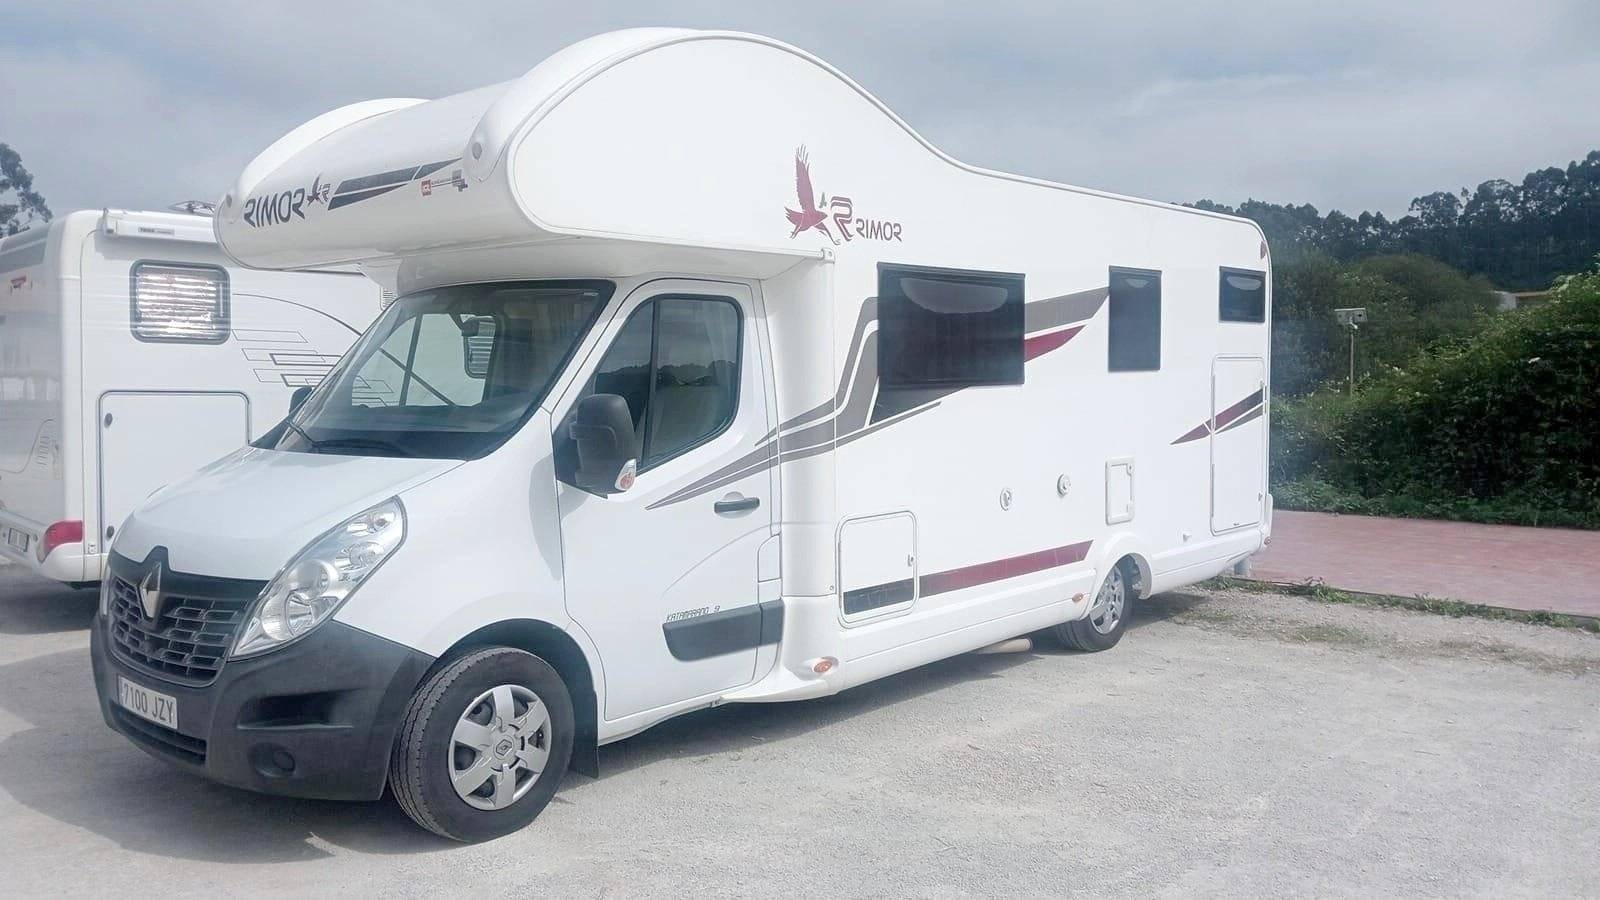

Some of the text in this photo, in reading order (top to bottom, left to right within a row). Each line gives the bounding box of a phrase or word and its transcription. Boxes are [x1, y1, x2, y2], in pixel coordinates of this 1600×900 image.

[244, 188, 305, 228] RIMOR
[855, 218, 903, 242] RIMOR
[124, 683, 173, 723] 7100 JZY
